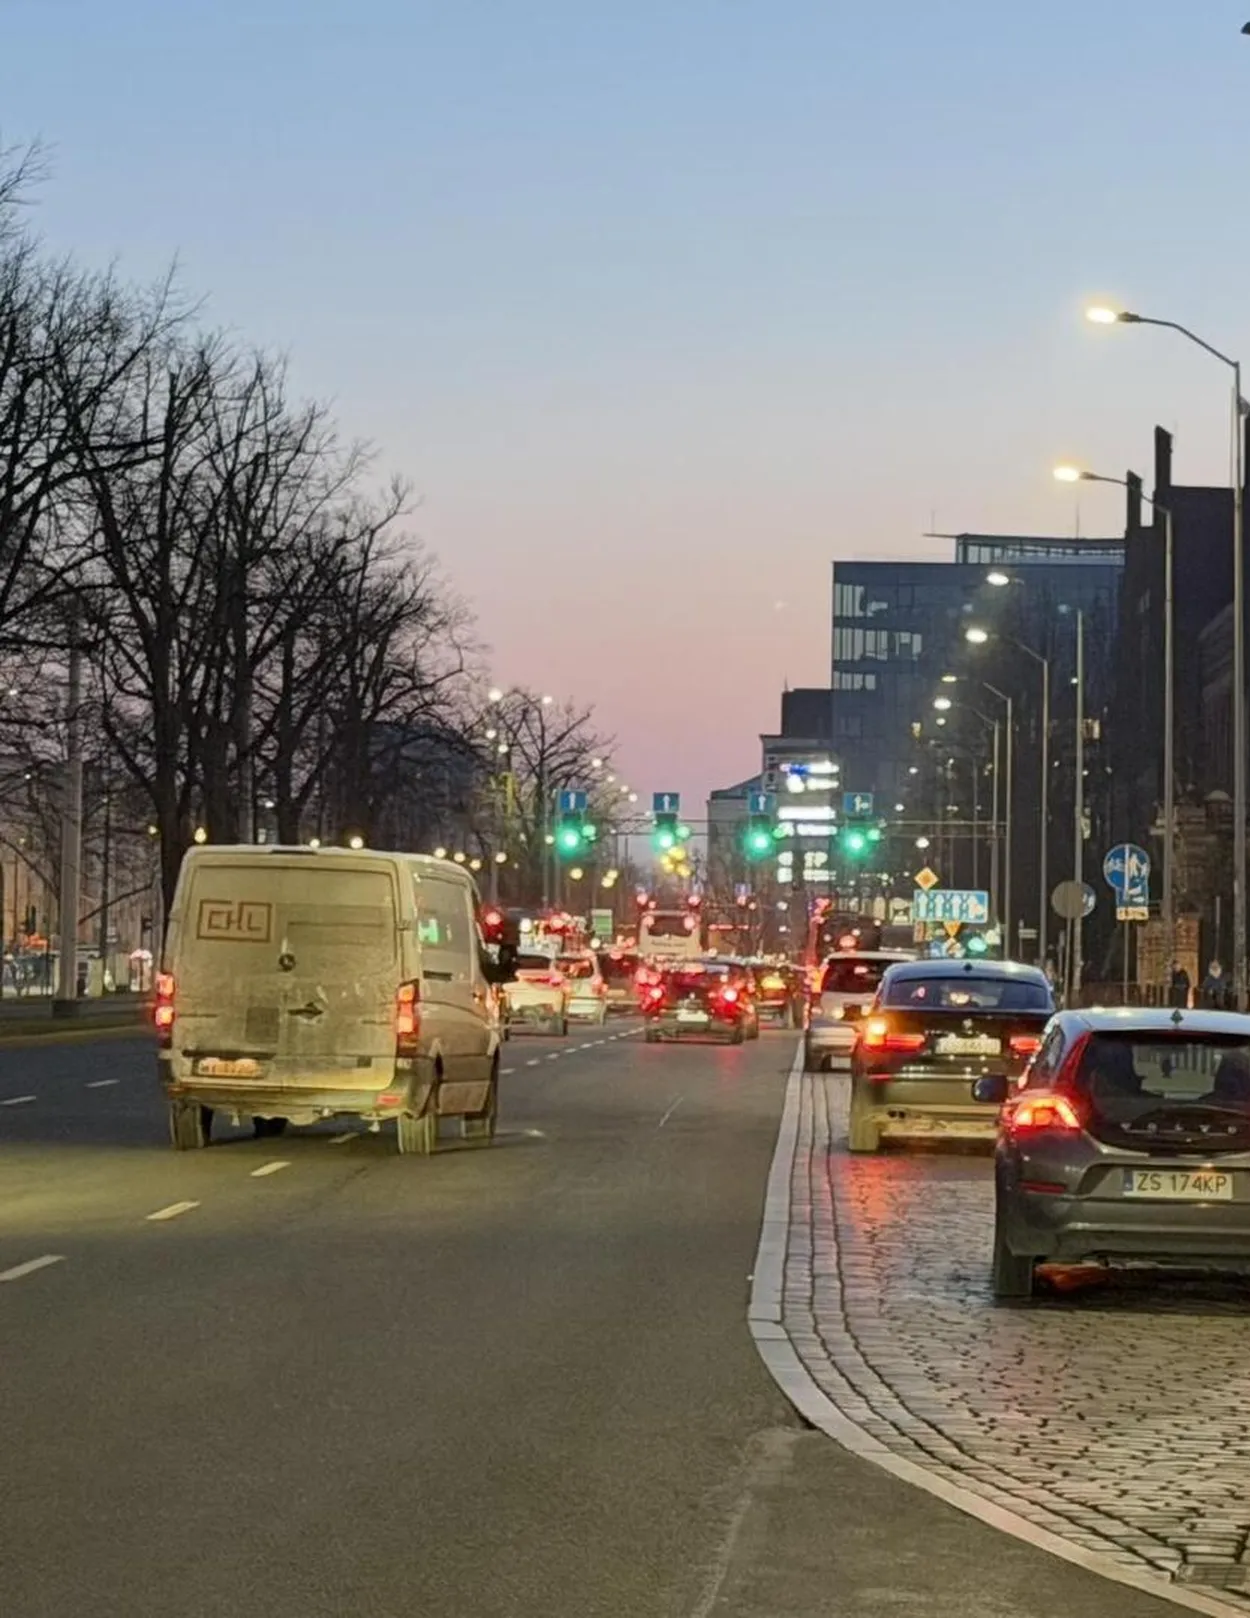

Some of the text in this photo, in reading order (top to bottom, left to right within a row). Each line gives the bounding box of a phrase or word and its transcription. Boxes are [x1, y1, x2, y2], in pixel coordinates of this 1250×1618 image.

[1120, 1122, 1237, 1135] VOLVO
[1136, 1173, 1228, 1195] ZS 174KP
